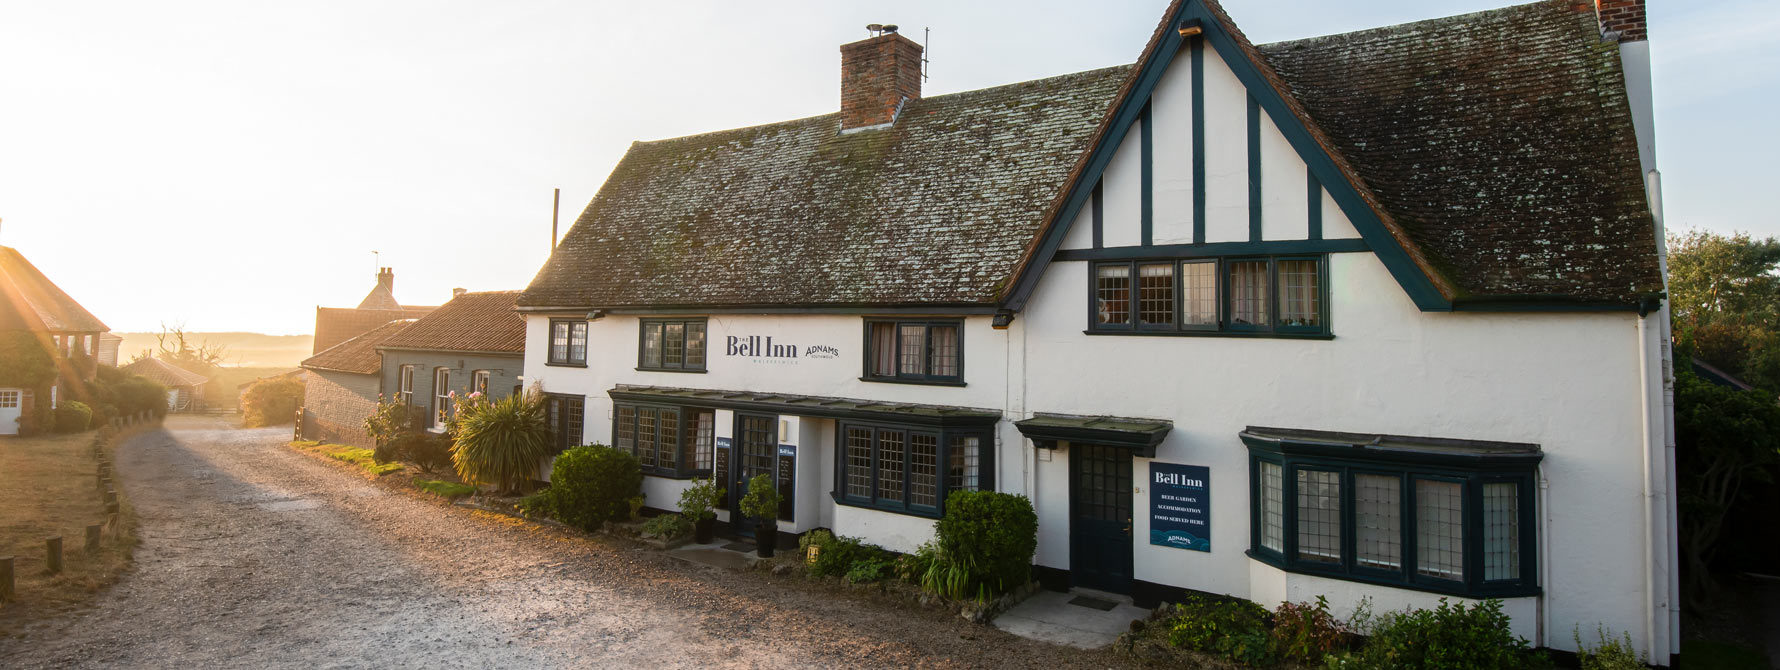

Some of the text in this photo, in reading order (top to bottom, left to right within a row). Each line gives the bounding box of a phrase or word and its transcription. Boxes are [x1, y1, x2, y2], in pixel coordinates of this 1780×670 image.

[726, 335, 797, 358] Bell Inn
[805, 345, 839, 356] ADNAMS
[1155, 472, 1203, 487] Bell Inn
